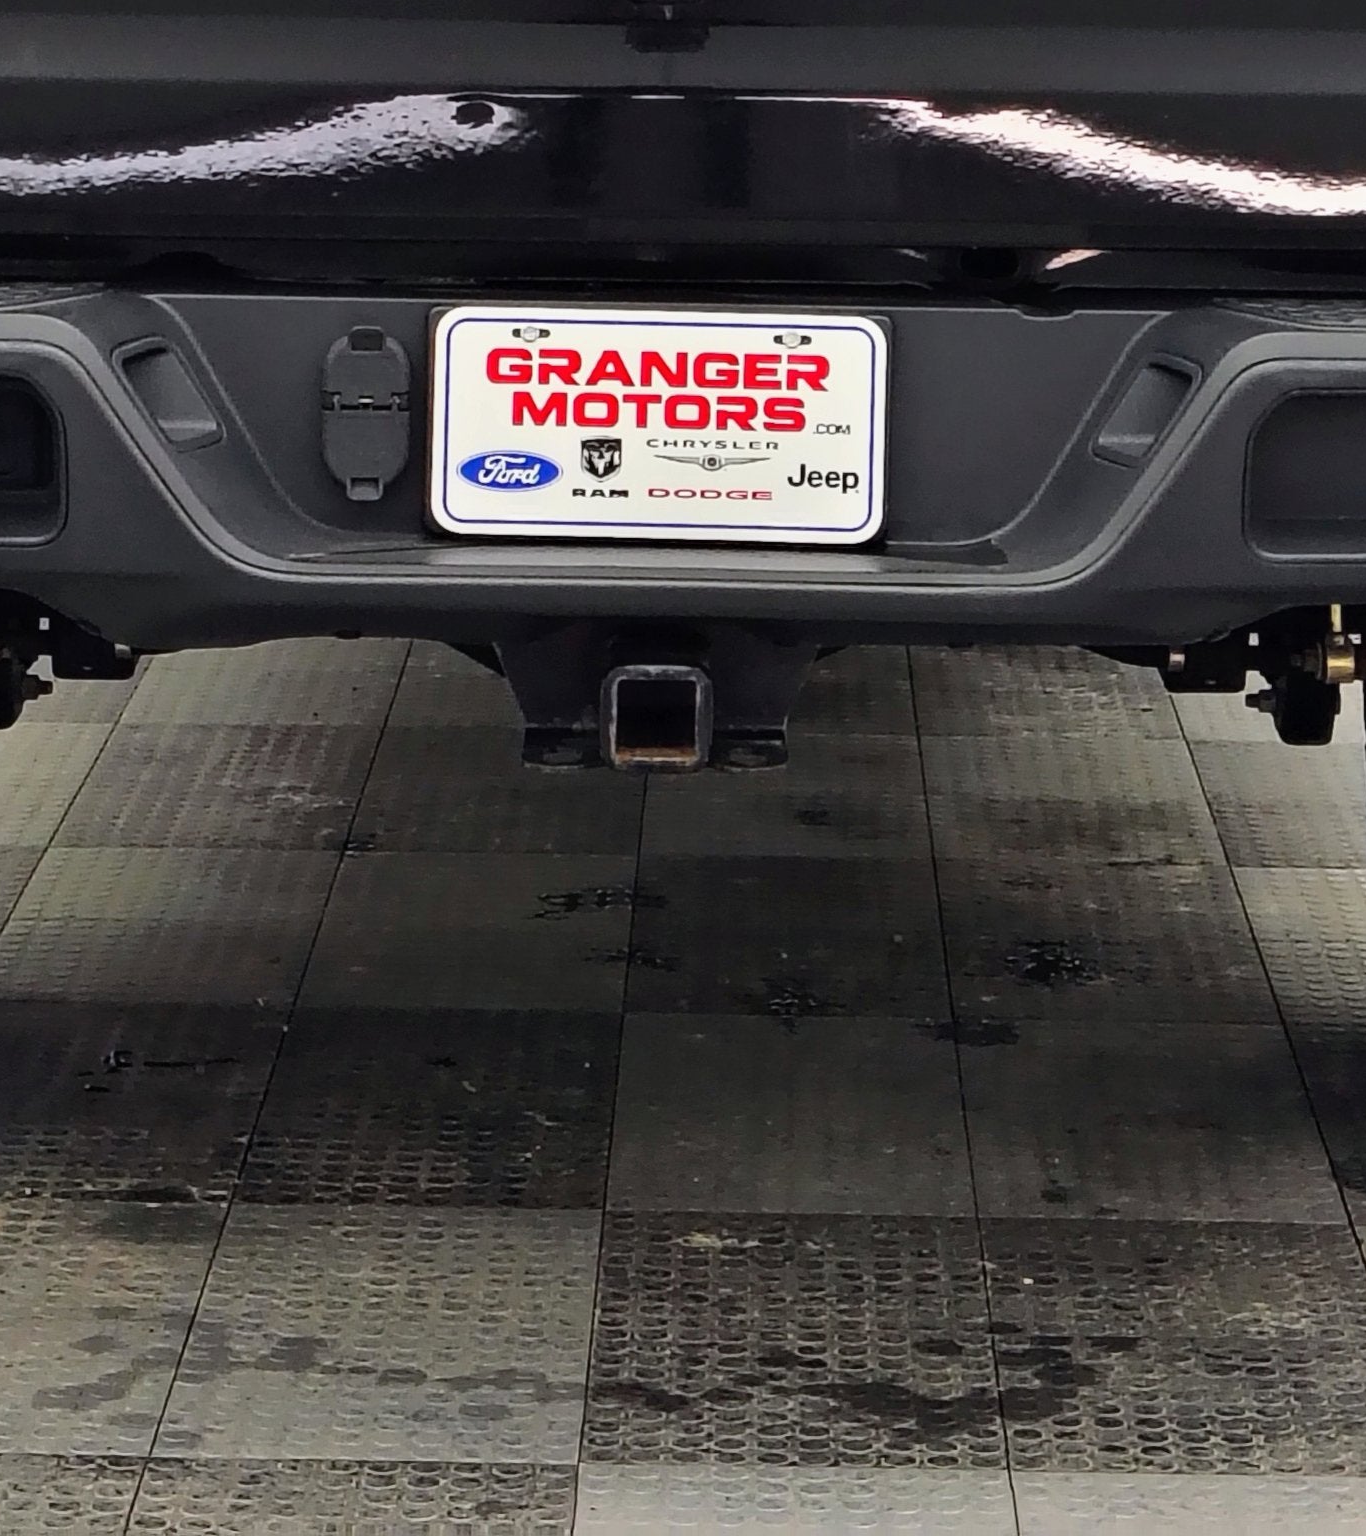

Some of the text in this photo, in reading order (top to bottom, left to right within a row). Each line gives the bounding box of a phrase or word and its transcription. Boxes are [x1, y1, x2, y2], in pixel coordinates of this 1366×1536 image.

[486, 348, 830, 392] GRANGER
[511, 392, 806, 432] MOTORS
[646, 438, 779, 450] CHRYSLER
[478, 454, 541, 485] Ford
[787, 463, 860, 494] Jeep
[572, 488, 629, 498] RAM
[647, 489, 773, 500] DODGE
